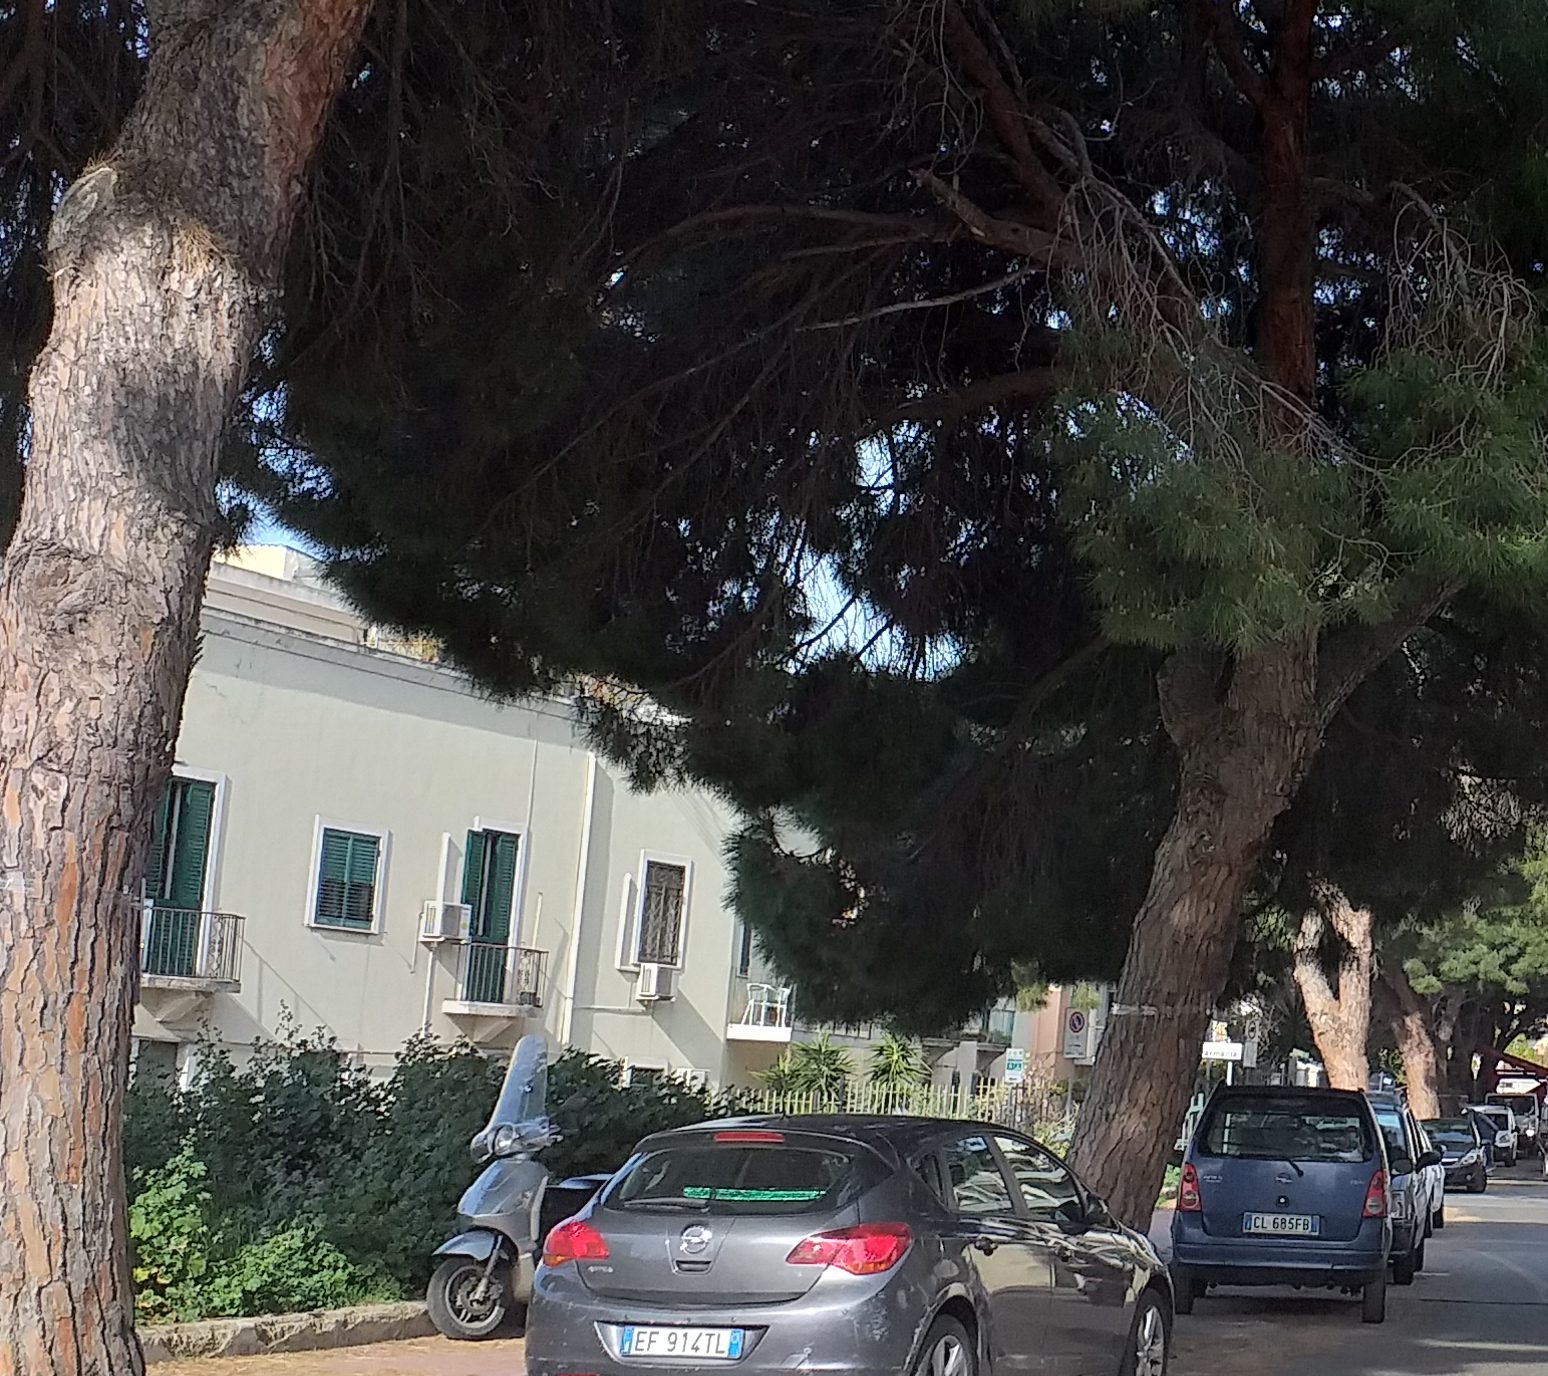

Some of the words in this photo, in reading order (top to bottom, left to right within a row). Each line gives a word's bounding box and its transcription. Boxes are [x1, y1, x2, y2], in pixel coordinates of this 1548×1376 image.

[1253, 1216, 1268, 1229] CL
[1272, 1217, 1310, 1231] 685FB
[634, 1331, 659, 1352] EF
[667, 1331, 725, 1354] 914TL
